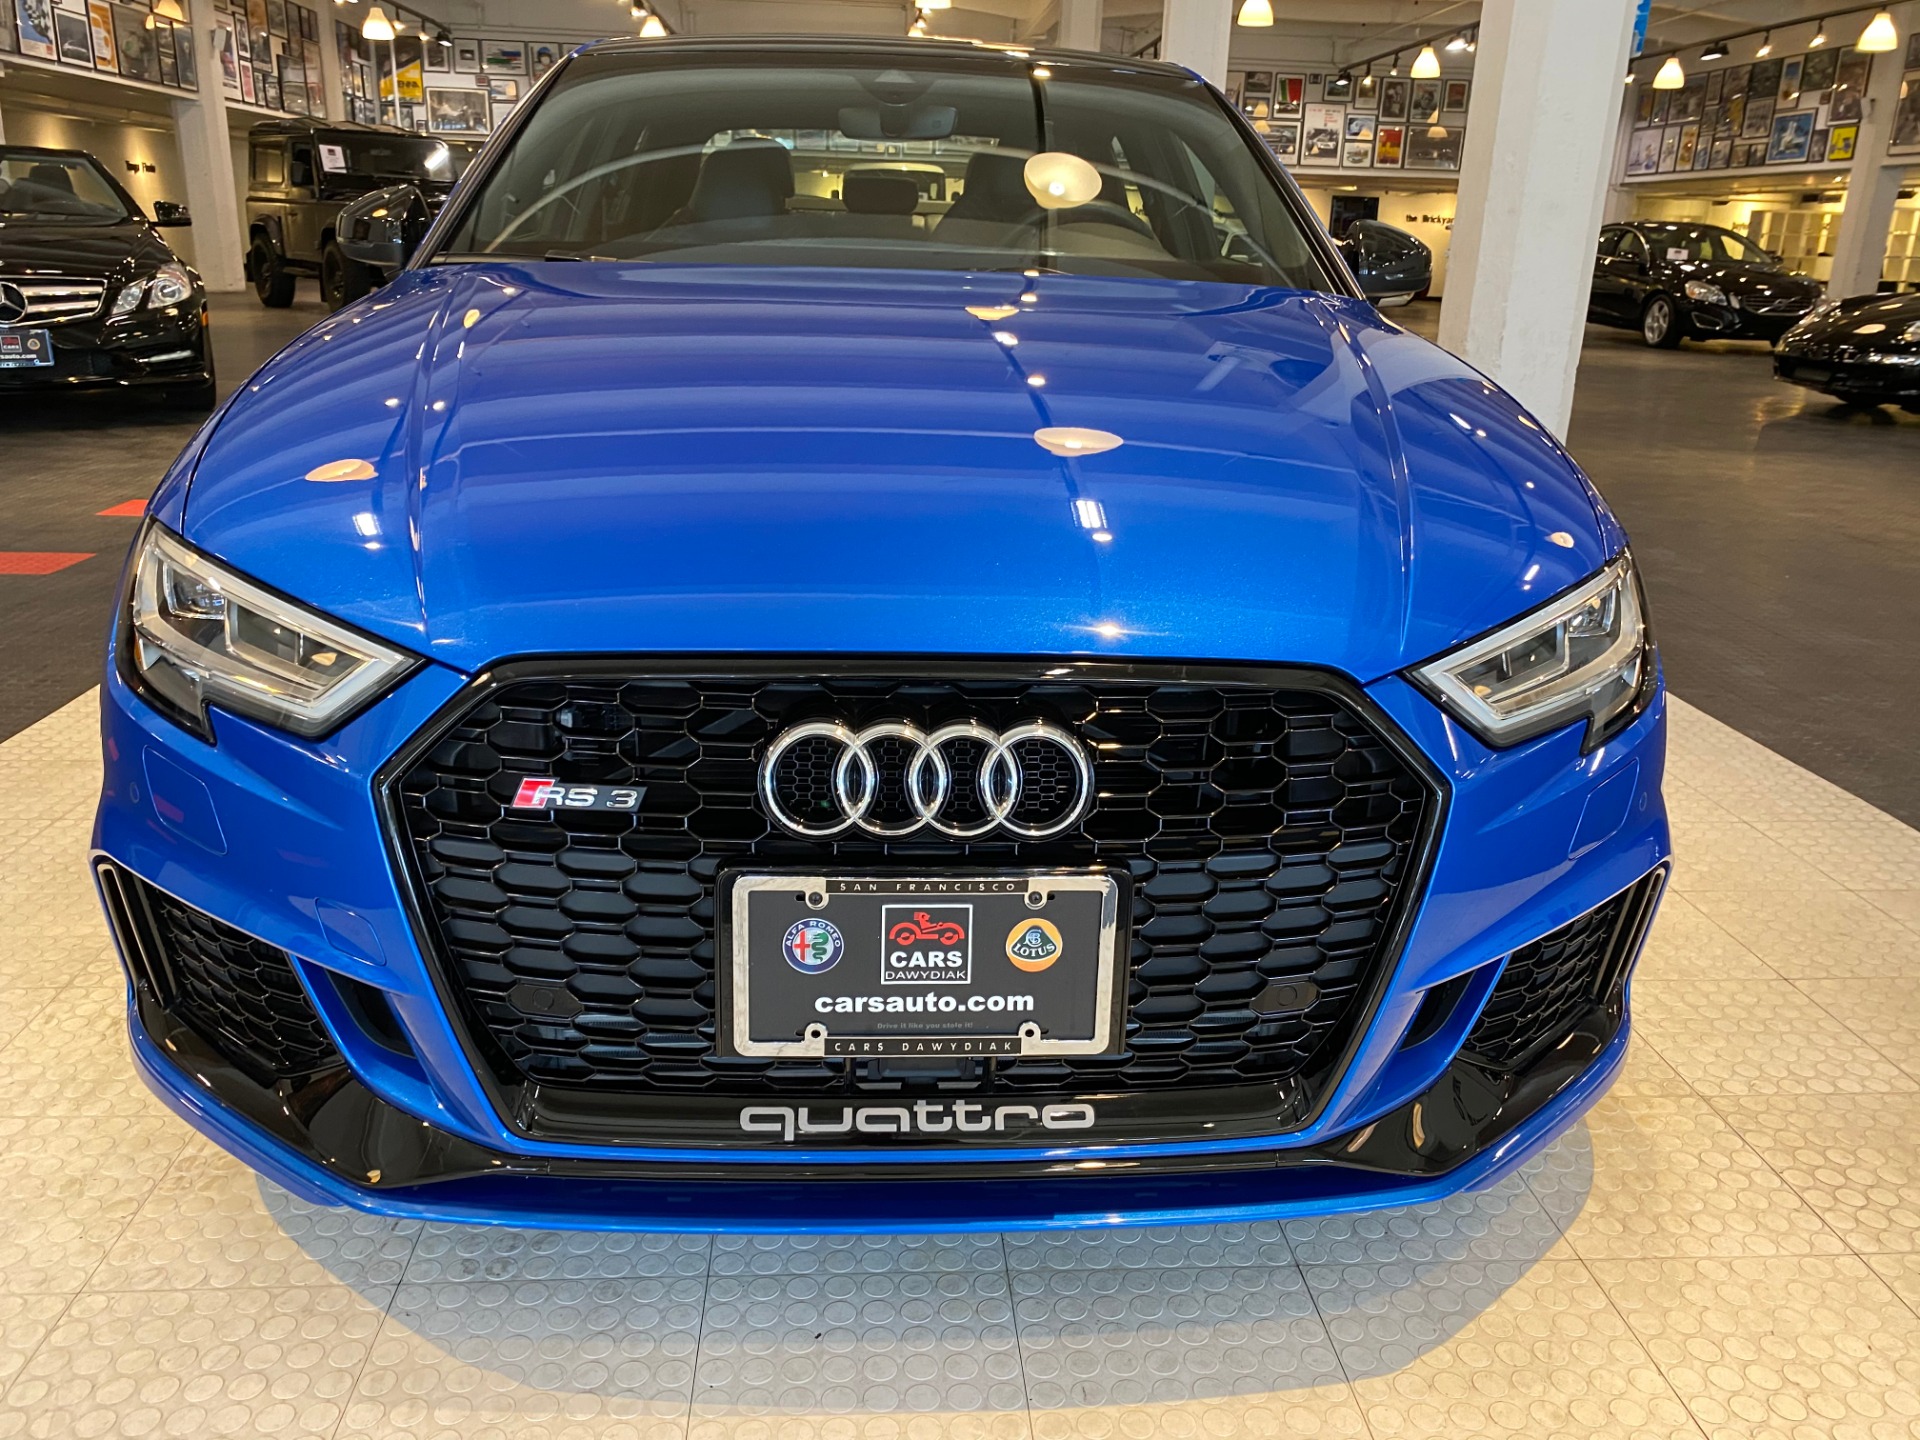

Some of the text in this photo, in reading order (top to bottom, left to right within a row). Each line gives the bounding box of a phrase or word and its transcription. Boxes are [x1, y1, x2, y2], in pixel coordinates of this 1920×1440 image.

[1422, 214, 1455, 225] Brickyar
[532, 785, 638, 809] RS 3
[840, 881, 1016, 893] SAN FRANCISCO
[785, 921, 841, 948] ALFA ROMEO
[1013, 942, 1055, 957] LOTUS
[889, 950, 963, 968] CARS
[884, 969, 966, 980] DAWYDIAK
[814, 991, 1035, 1013] carsauto.com
[834, 1042, 1013, 1052] CARS DAWYDIAK
[739, 1099, 1096, 1142] quattro
